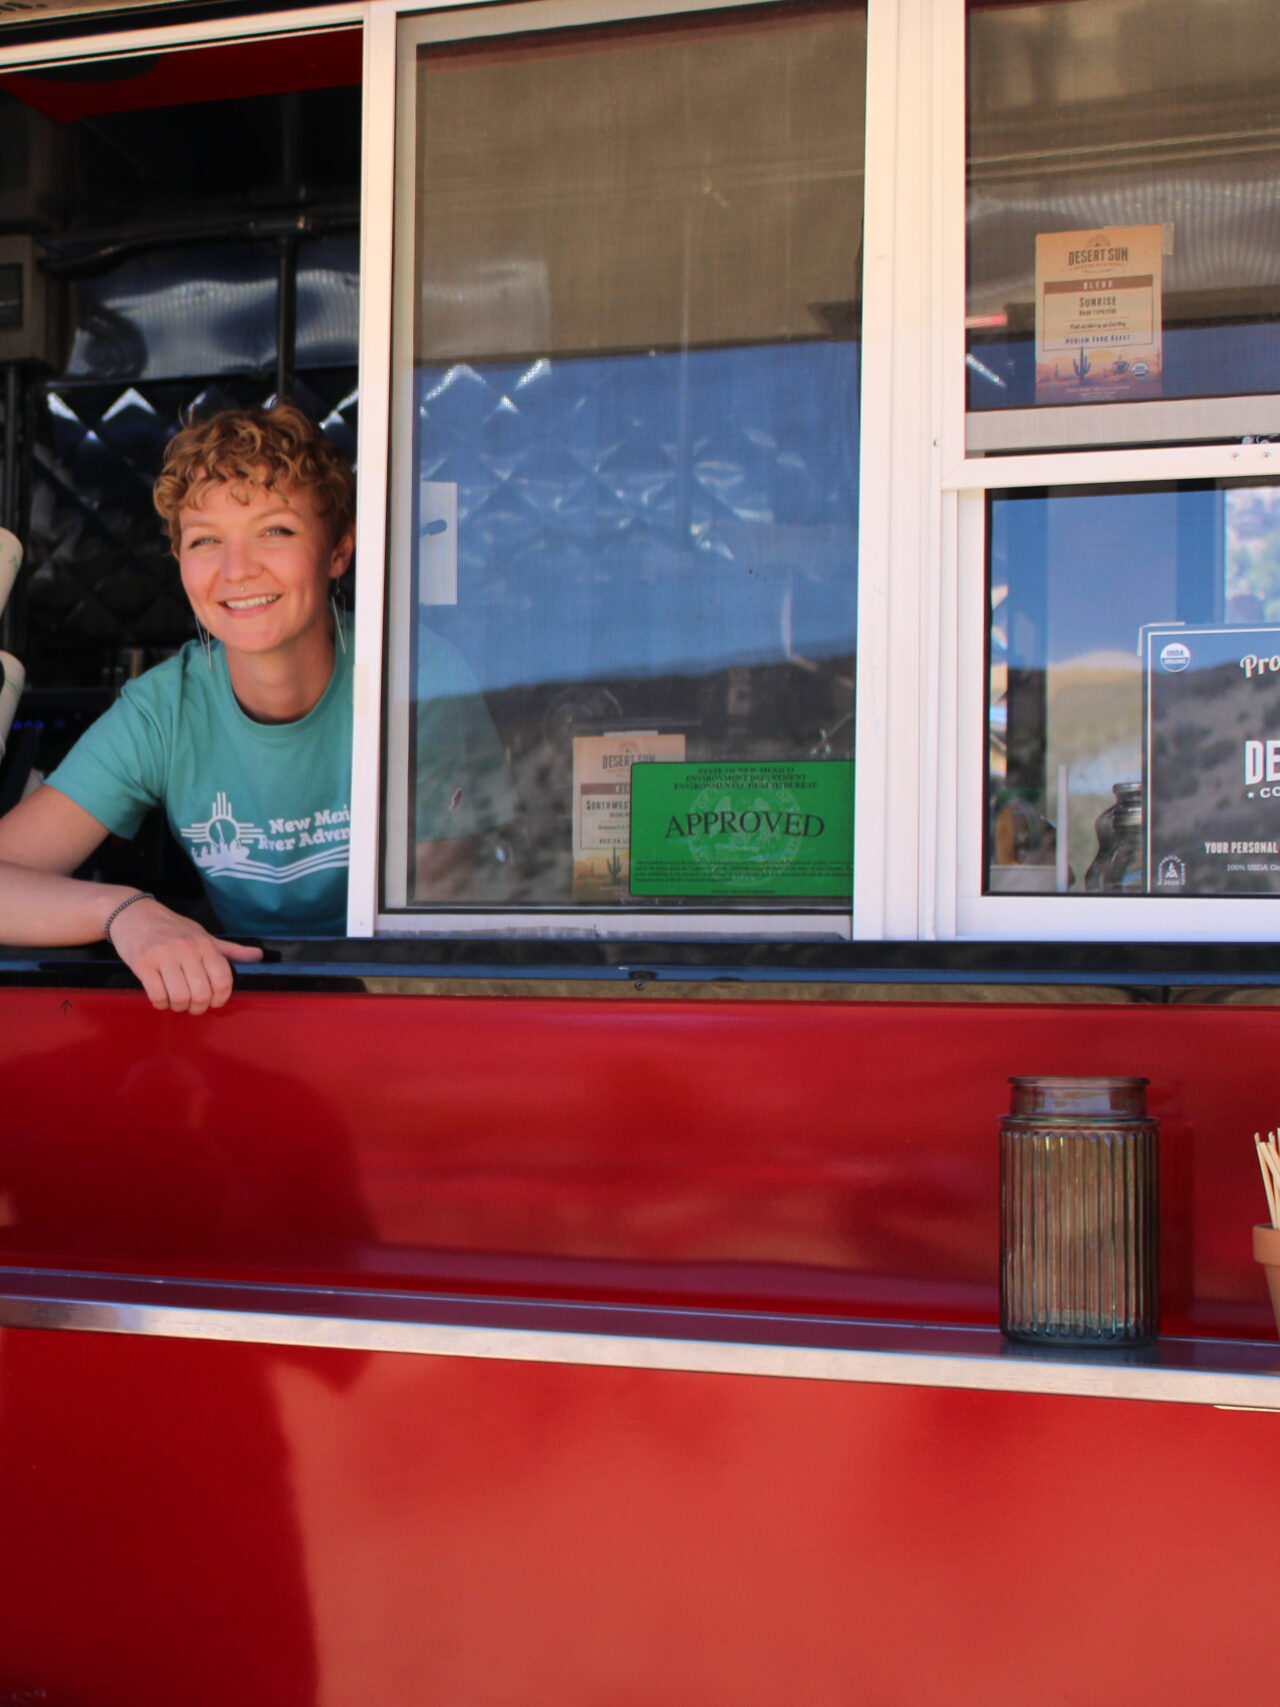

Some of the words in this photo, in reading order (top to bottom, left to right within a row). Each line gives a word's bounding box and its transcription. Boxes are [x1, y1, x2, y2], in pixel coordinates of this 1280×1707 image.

[1068, 247, 1106, 266] DESERT
[1107, 246, 1128, 262] SUN
[1083, 280, 1113, 290] BLEND
[1079, 296, 1117, 308] SUNRISE
[1240, 654, 1280, 678] Pro
[1245, 740, 1280, 785] DE
[1260, 786, 1280, 798] CO
[268, 817, 311, 834] New
[666, 811, 825, 839] APPROVED
[258, 834, 296, 852] Rver
[1204, 841, 1229, 854] YOUR
[1231, 841, 1278, 854] PERSONAL
